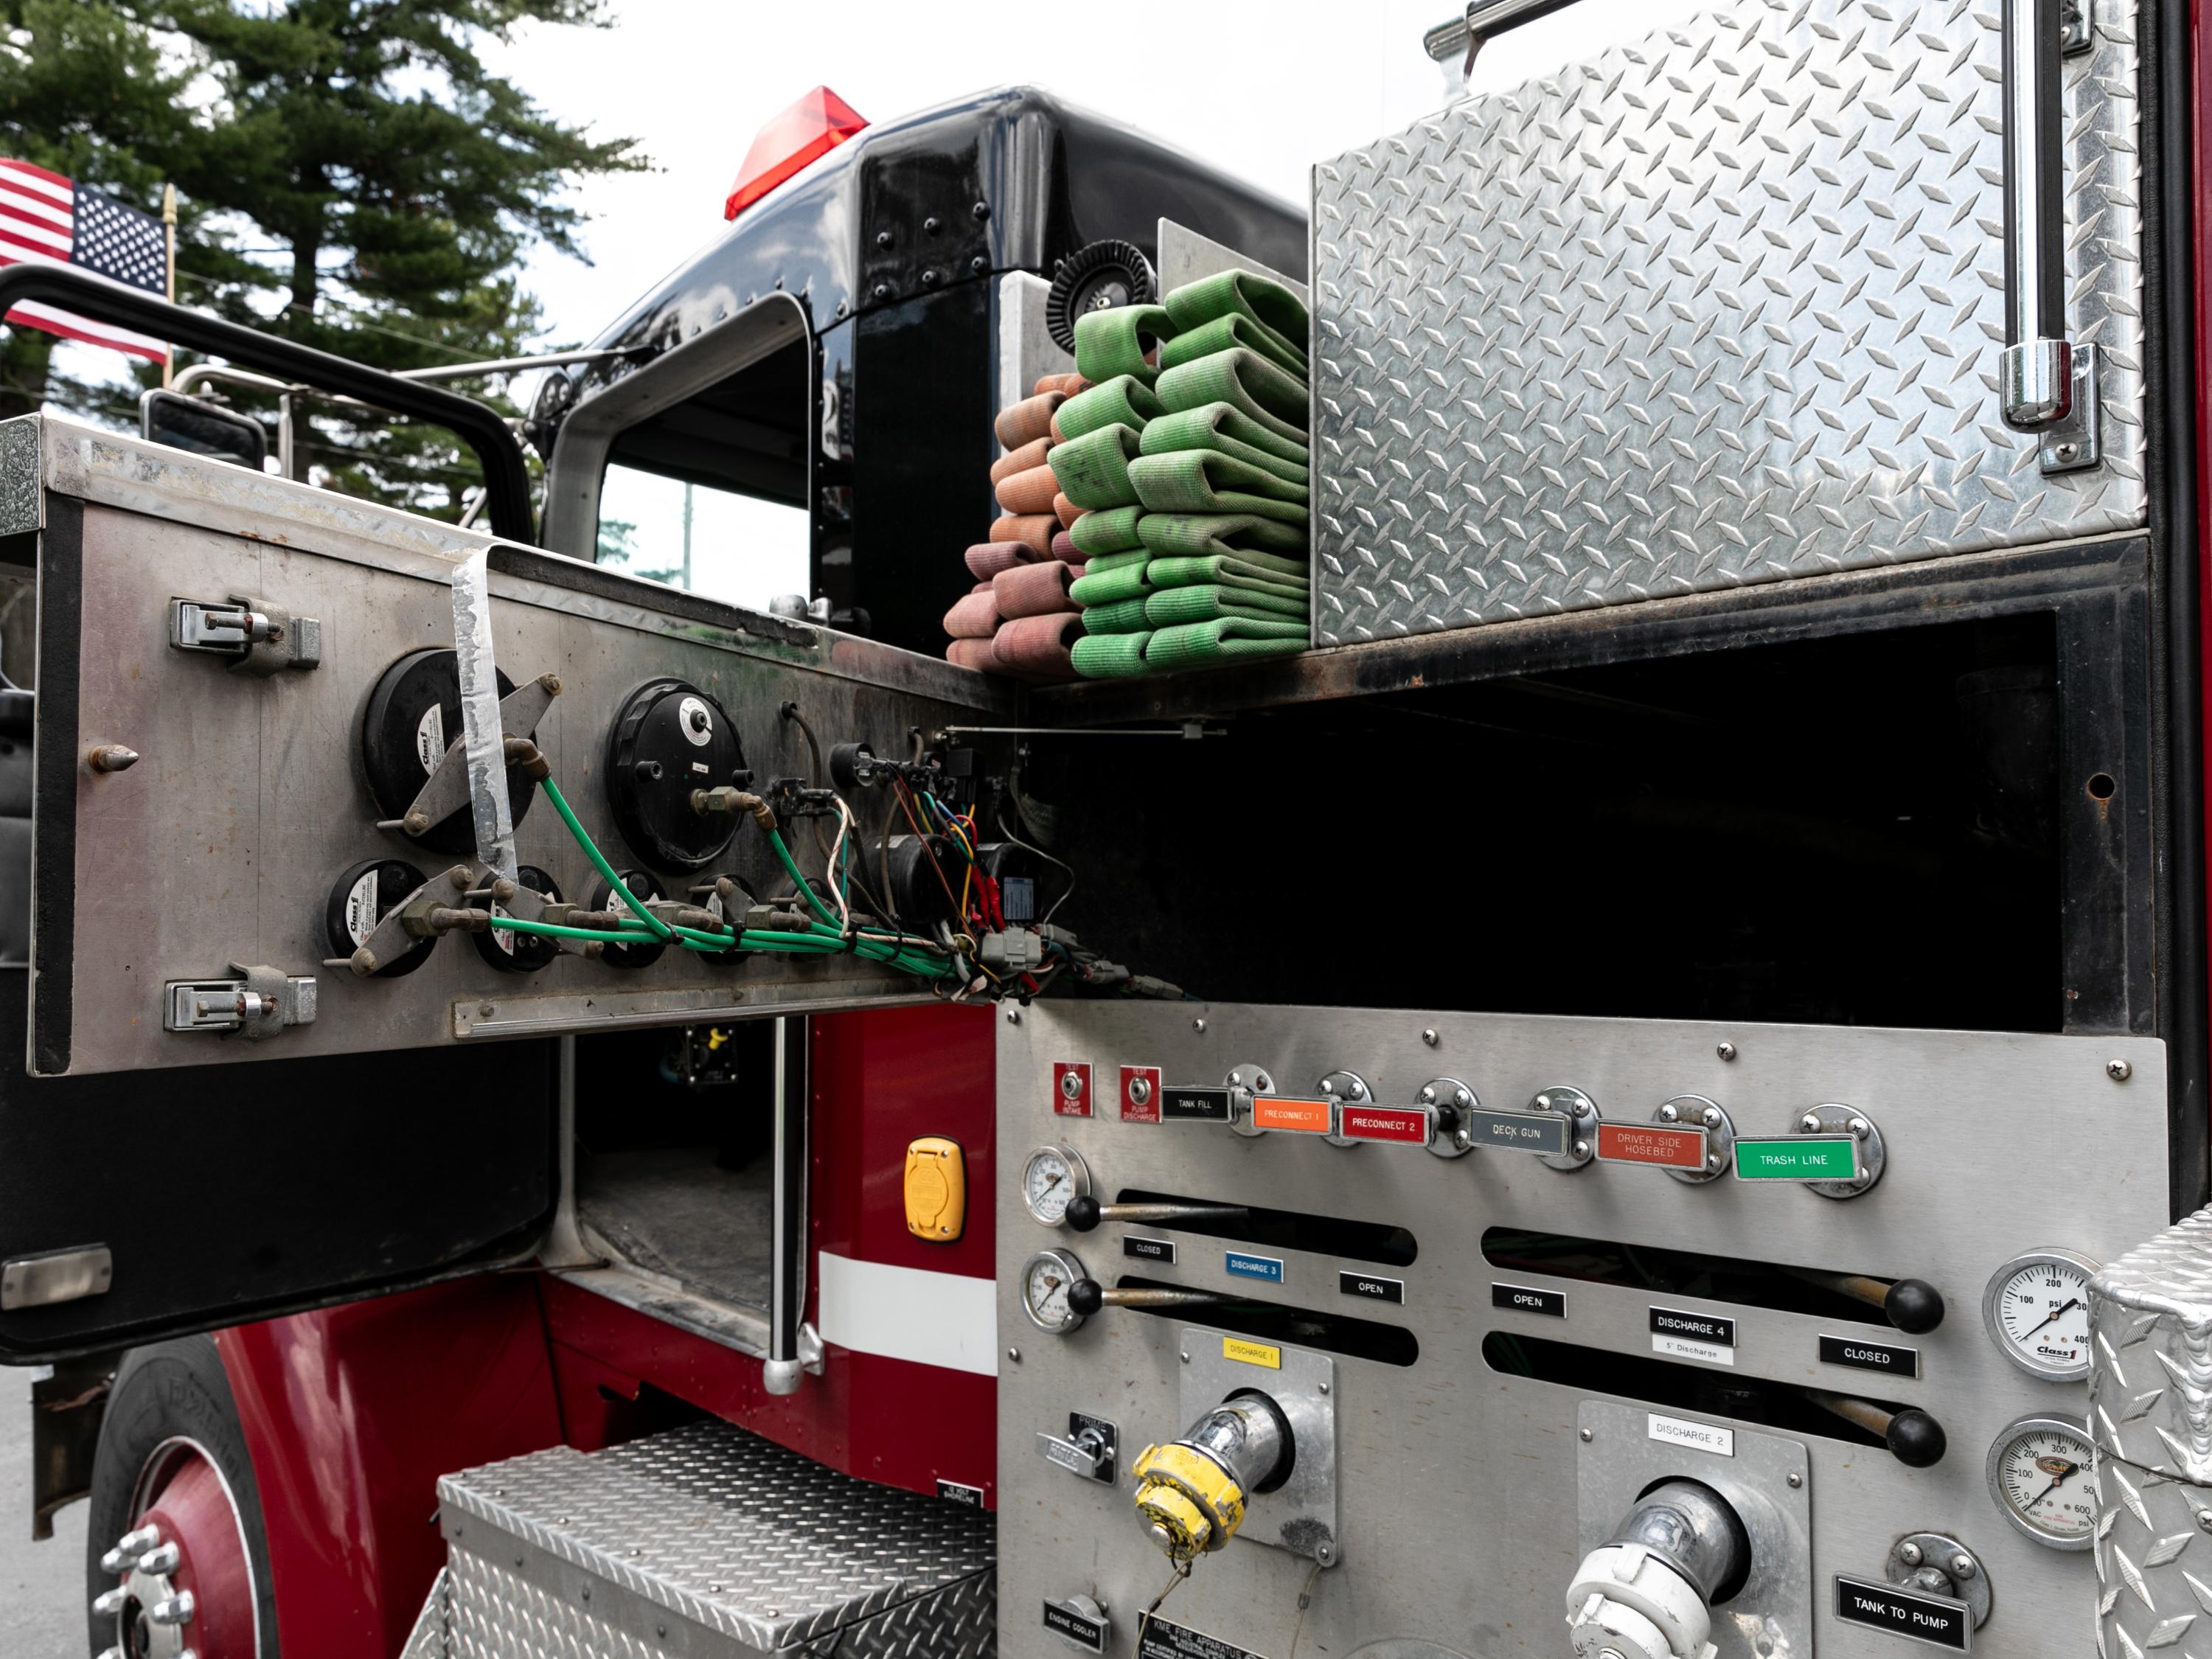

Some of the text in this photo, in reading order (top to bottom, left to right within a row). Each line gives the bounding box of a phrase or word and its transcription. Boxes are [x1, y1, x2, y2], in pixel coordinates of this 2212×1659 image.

[1133, 1068, 1147, 1076] TEST
[1178, 1099, 1212, 1109] TANK FILL
[1062, 1107, 1082, 1115] INTAKE
[1123, 1112, 1157, 1121] DISCHARGE
[1264, 1110, 1312, 1121] PRECONNECT
[1352, 1118, 1416, 1132] PRECONNECT 2
[1492, 1124, 1541, 1139] DECK GUN
[1617, 1133, 1682, 1148] DRIVER SIDE
[1625, 1144, 1674, 1158] HOSEBED
[1759, 1155, 1829, 1165] TRASH LINE
[1136, 1244, 1161, 1255] CLOSED
[1231, 1259, 1277, 1275] DISCHARGE 3
[1358, 1281, 1384, 1295] OPEN
[2045, 1279, 2062, 1288] 200
[1514, 1294, 1543, 1307] OPEN
[2020, 1295, 2034, 1304] 100
[2048, 1300, 2062, 1309] psi
[2076, 1302, 2087, 1311] 30
[1658, 1316, 1725, 1337] DISCHARGE 4
[1230, 1344, 1267, 1360] DISCHARGE
[1677, 1344, 1717, 1357] Discharge
[1844, 1348, 1891, 1364] CLOSED
[1079, 1416, 1107, 1433] PRIME
[1656, 1423, 1725, 1446] DISCHARGE 2
[2023, 1449, 2039, 1459] 200
[2051, 1444, 2067, 1455] 300
[2018, 1469, 2034, 1479] 100
[2083, 1485, 2095, 1495] 50
[2024, 1492, 2030, 1500] 0
[2028, 1509, 2042, 1518] VAC
[2074, 1504, 2091, 1515] 600
[1854, 1596, 1949, 1630] TANK TO PUMP
[1048, 1612, 1096, 1640] ENGINE COOLER
[1154, 1619, 1242, 1659] KME FIRE APPARATUS
